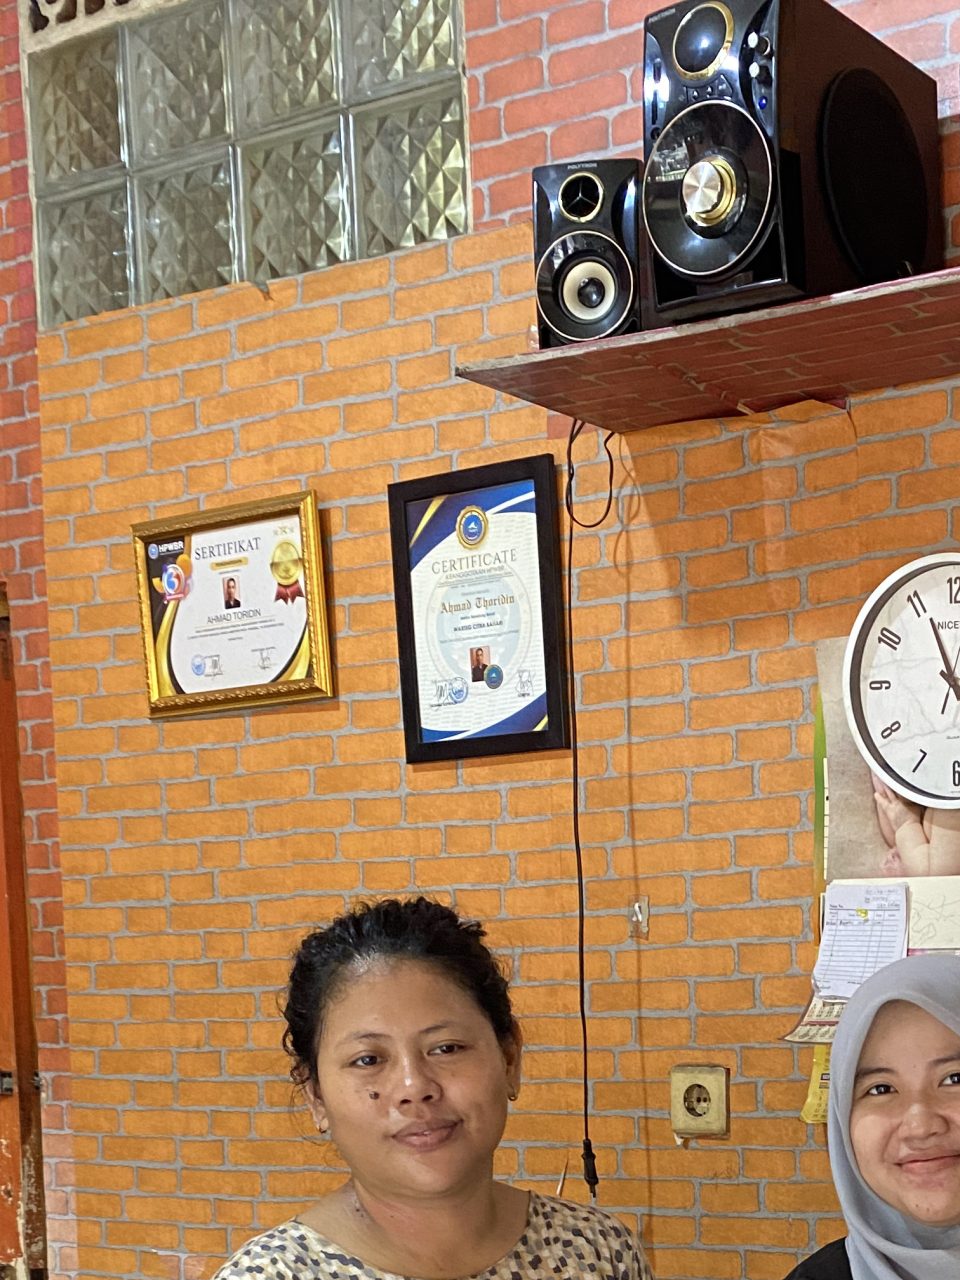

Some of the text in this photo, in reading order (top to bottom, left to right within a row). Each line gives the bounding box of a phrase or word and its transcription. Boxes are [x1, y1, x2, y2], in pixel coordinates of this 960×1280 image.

[194, 537, 262, 560] SERTIFIKAT
[431, 548, 518, 575] CERTIFICATE
[440, 594, 515, 614] Ahmad Thoridin
[907, 590, 927, 618] 11
[207, 609, 262, 624] AHMAD TORIDIN
[878, 626, 902, 651] 10
[869, 679, 892, 690] 9
[881, 720, 902, 740] 8
[912, 749, 927, 773] 7
